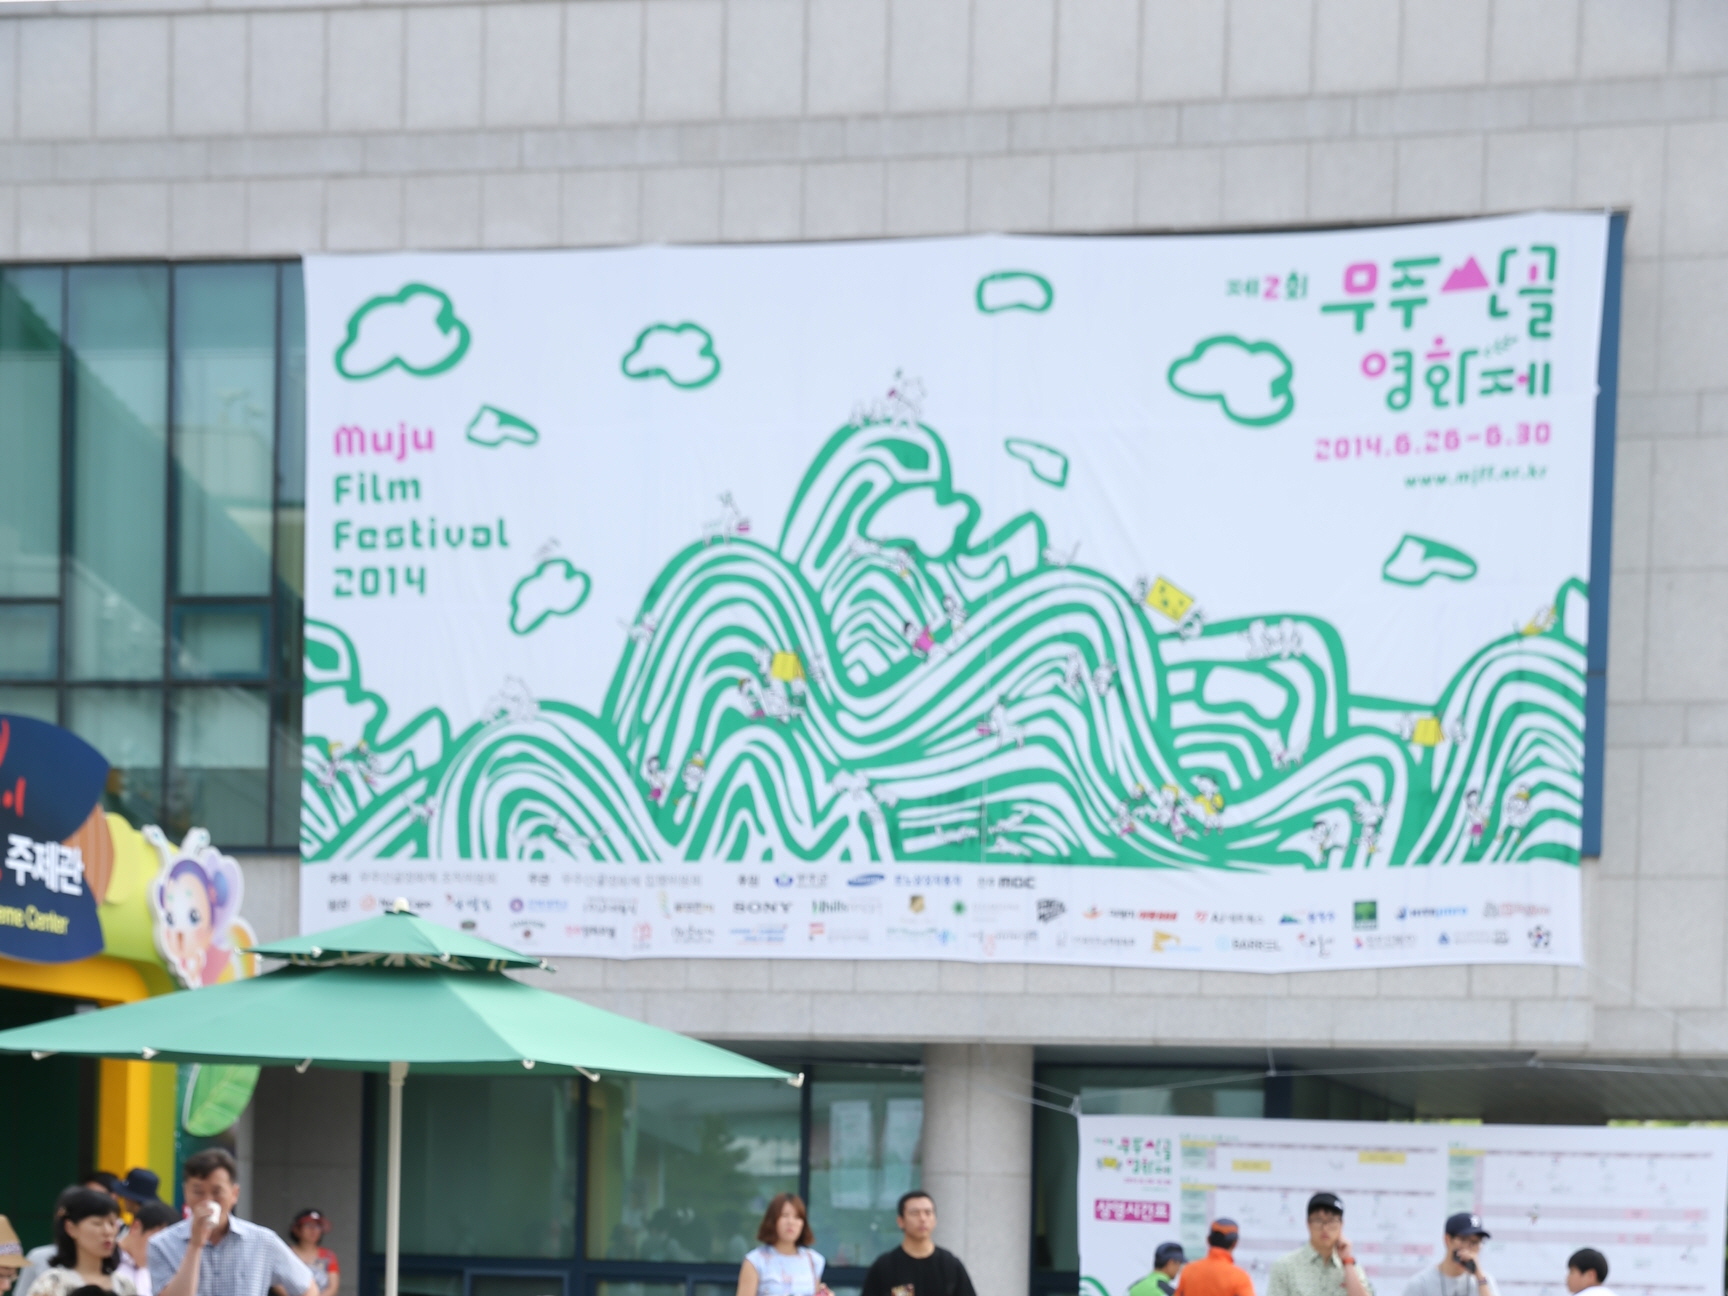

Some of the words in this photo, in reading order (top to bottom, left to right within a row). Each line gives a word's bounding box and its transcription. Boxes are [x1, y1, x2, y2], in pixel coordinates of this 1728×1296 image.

[1225, 270, 1309, 300] 제2회
[1361, 336, 1552, 411] 영화제
[334, 421, 435, 462] Muju
[334, 472, 421, 503] Film
[334, 516, 509, 550] Festival
[333, 566, 426, 597] 2014
[5, 833, 85, 896] 주제관
[733, 900, 792, 914] SONY
